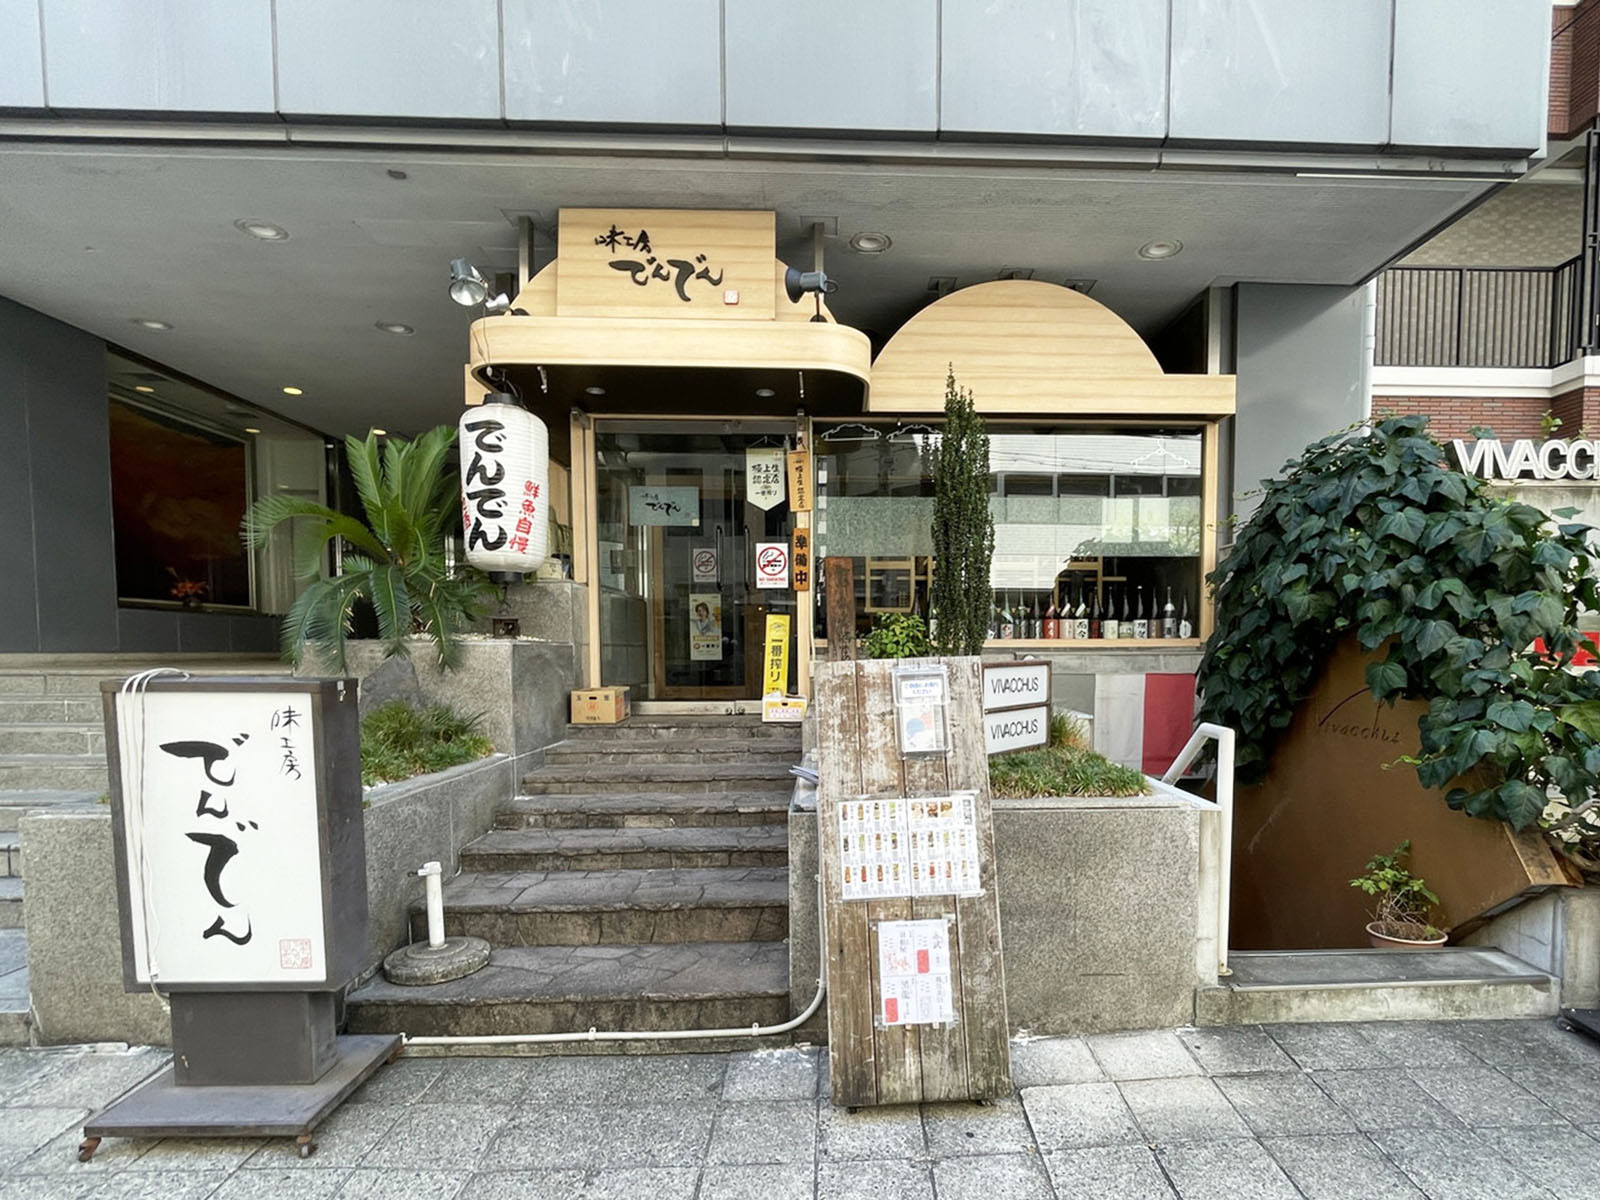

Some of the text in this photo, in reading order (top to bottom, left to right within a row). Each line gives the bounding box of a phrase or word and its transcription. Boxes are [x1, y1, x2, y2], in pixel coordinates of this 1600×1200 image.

[595, 224, 652, 254] 味工房
[608, 254, 723, 302] でんでん
[1452, 439, 1600, 479] VIVACC
[465, 420, 508, 551] でんでん
[795, 534, 808, 585] 準備中
[770, 639, 784, 682] 一番搾り
[991, 676, 1039, 694] VIVACCHUS
[271, 705, 302, 780] 味工房
[990, 718, 1038, 740] VIVACCHUS
[159, 733, 258, 946] でんでん
